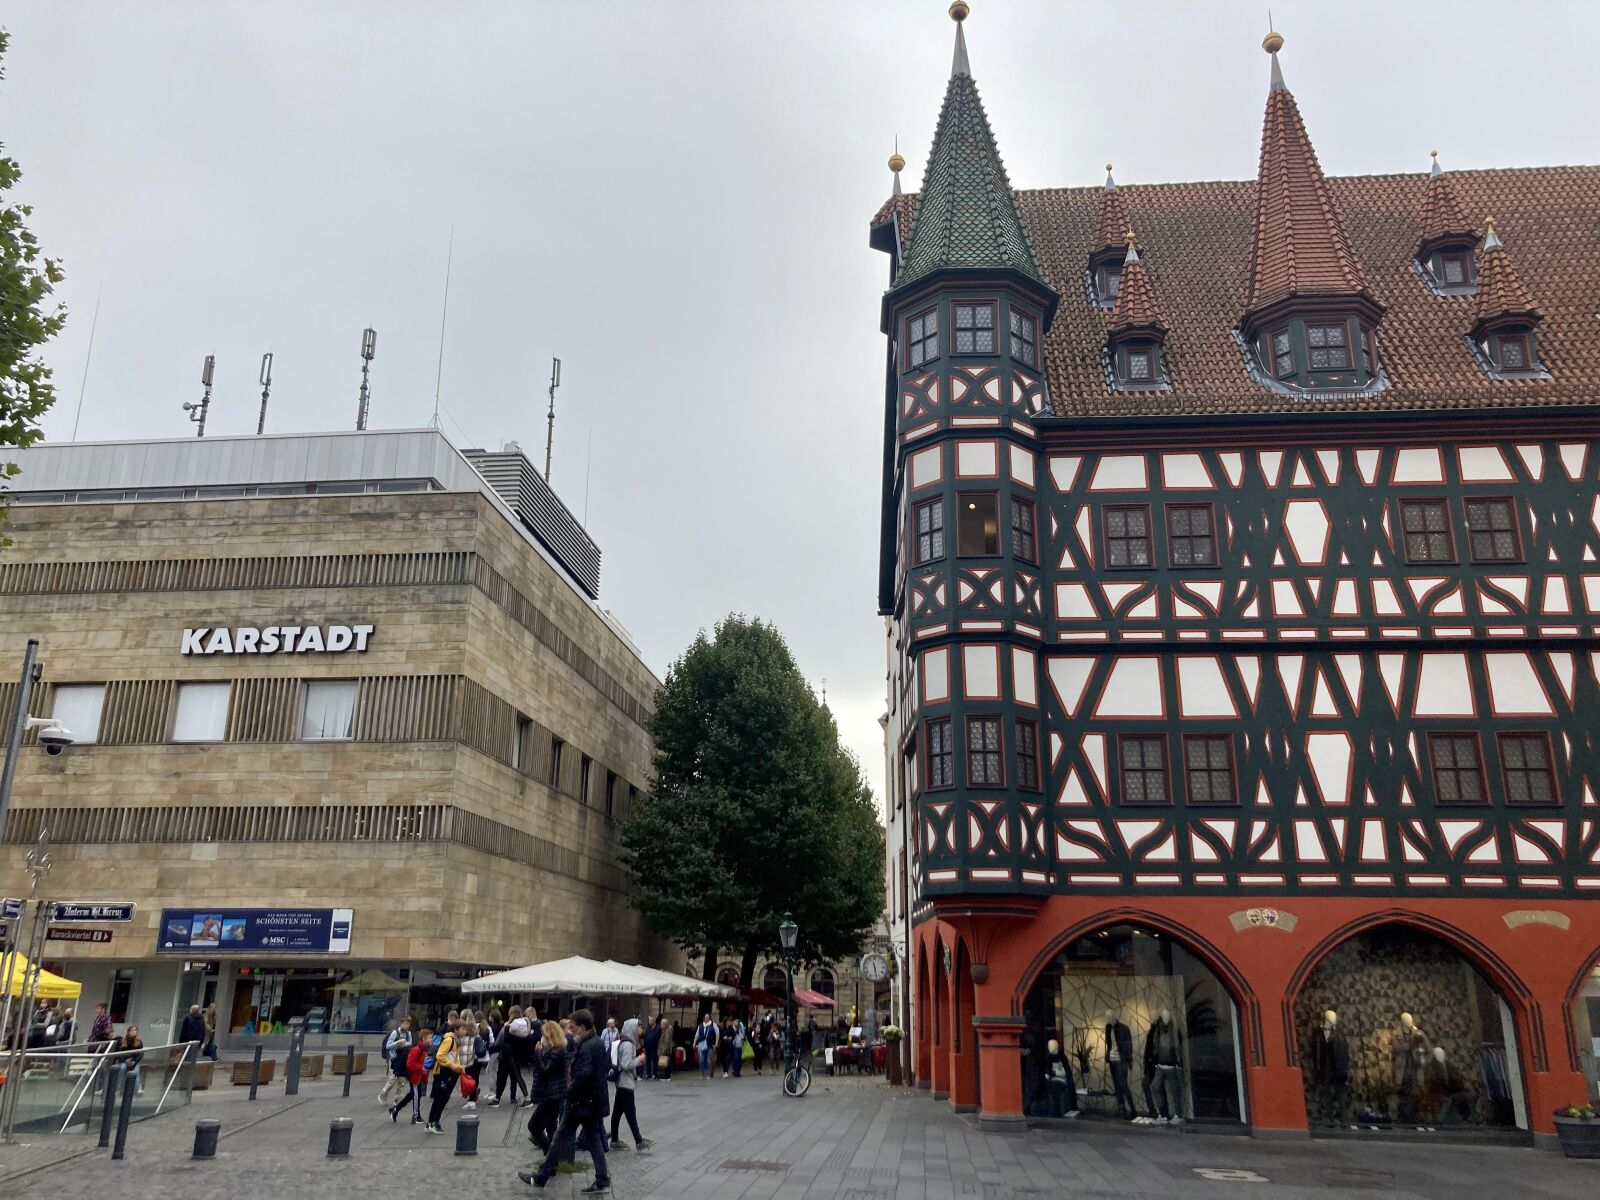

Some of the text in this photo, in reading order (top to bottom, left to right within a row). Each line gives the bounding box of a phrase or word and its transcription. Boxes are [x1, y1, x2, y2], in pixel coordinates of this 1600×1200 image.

[180, 624, 374, 654] KARSTADT
[63, 906, 90, 917] Unterm
[255, 917, 299, 925] SCHÖNSTEN
[50, 929, 92, 940] Barockviertel
[269, 936, 286, 944] MSC
[243, 1020, 285, 1034] AIDA
